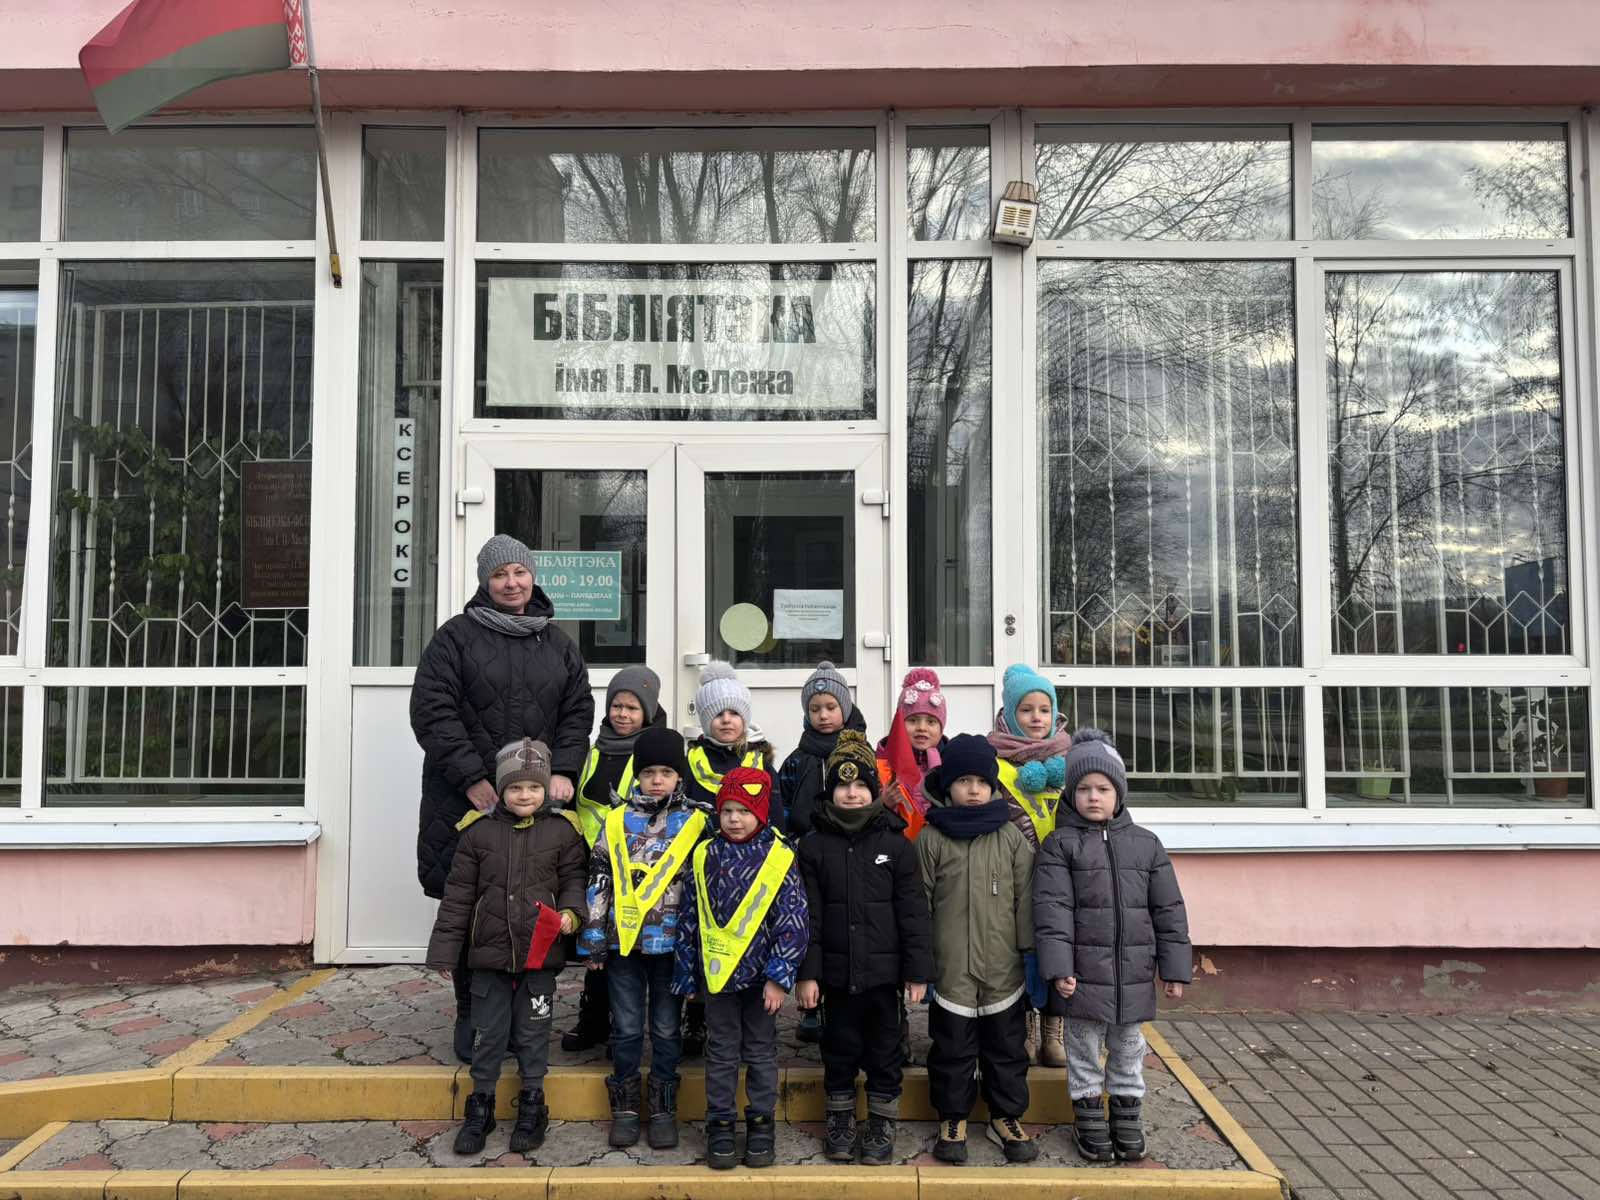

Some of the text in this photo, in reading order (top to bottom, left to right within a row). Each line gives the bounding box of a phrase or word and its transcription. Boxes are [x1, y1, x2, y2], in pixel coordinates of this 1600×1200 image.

[555, 362, 795, 395] імя І.П. Мележа
[394, 423, 412, 582] КСЕРОКС
[579, 574, 614, 587] 19.00
